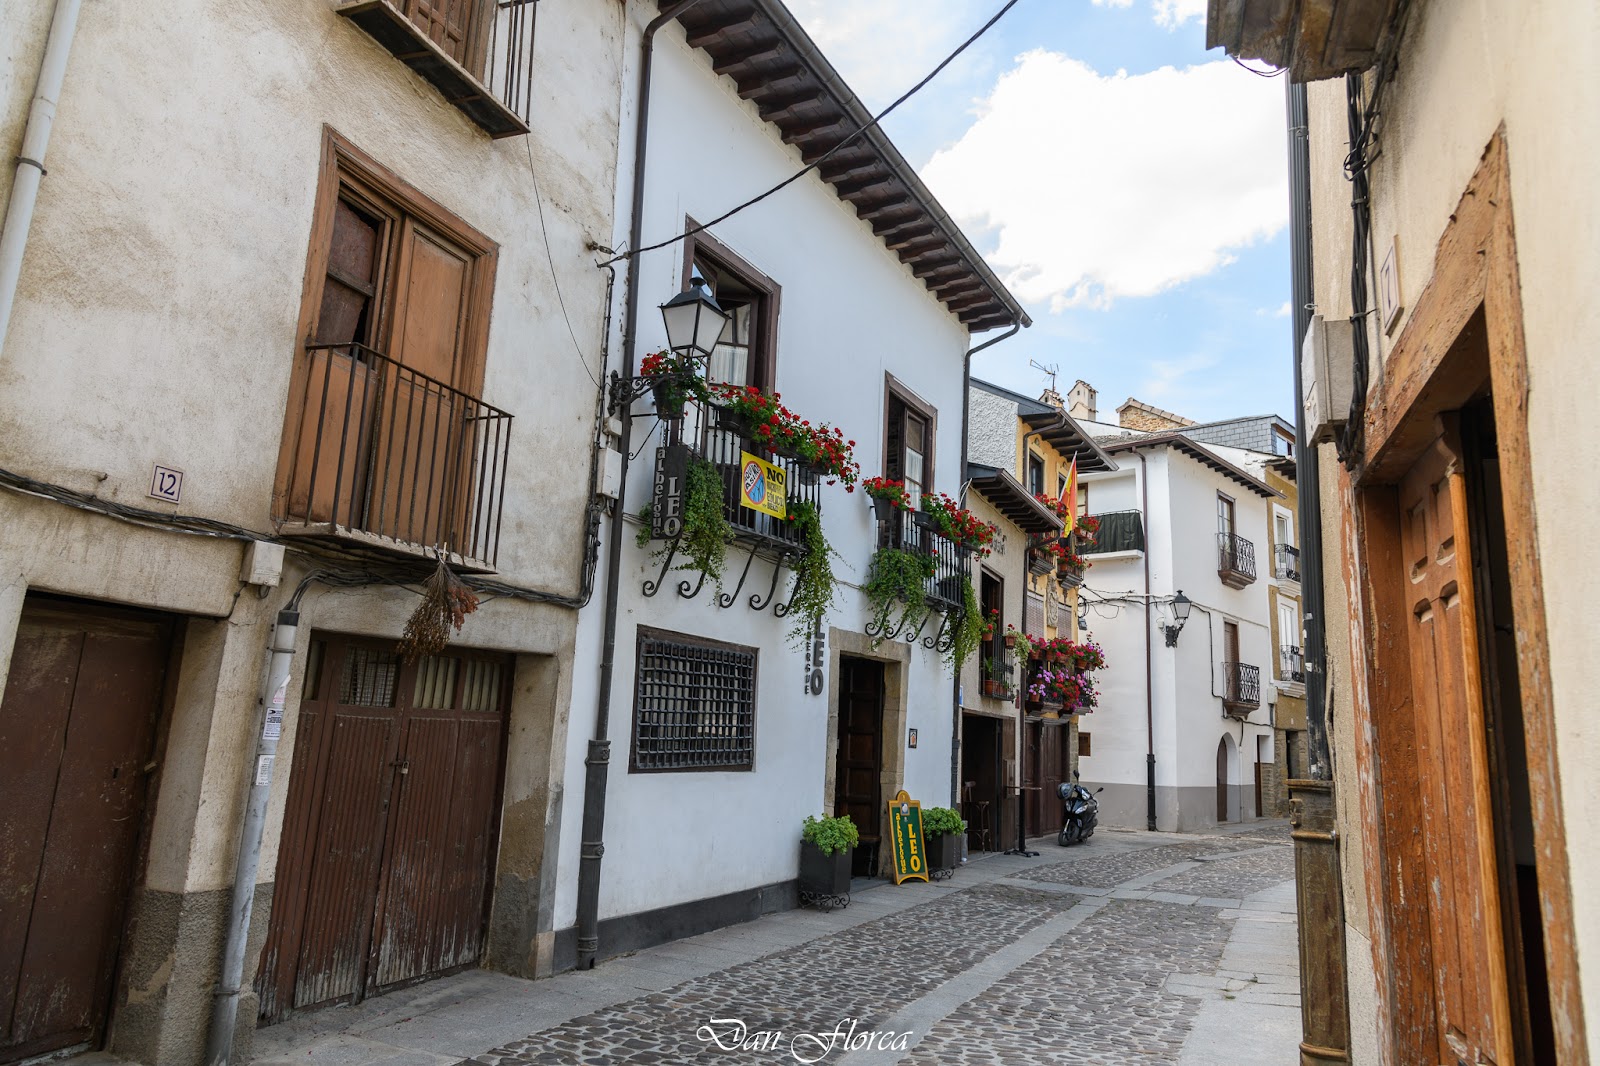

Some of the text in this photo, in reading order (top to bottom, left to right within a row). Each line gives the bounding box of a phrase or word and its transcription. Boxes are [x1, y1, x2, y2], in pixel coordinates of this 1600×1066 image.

[159, 472, 177, 496] 12
[652, 448, 665, 537] albergue
[663, 476, 681, 537] LEO
[766, 467, 784, 485] NO
[811, 613, 825, 696] LEO
[896, 812, 906, 874] albergue
[907, 823, 921, 872] LEO
